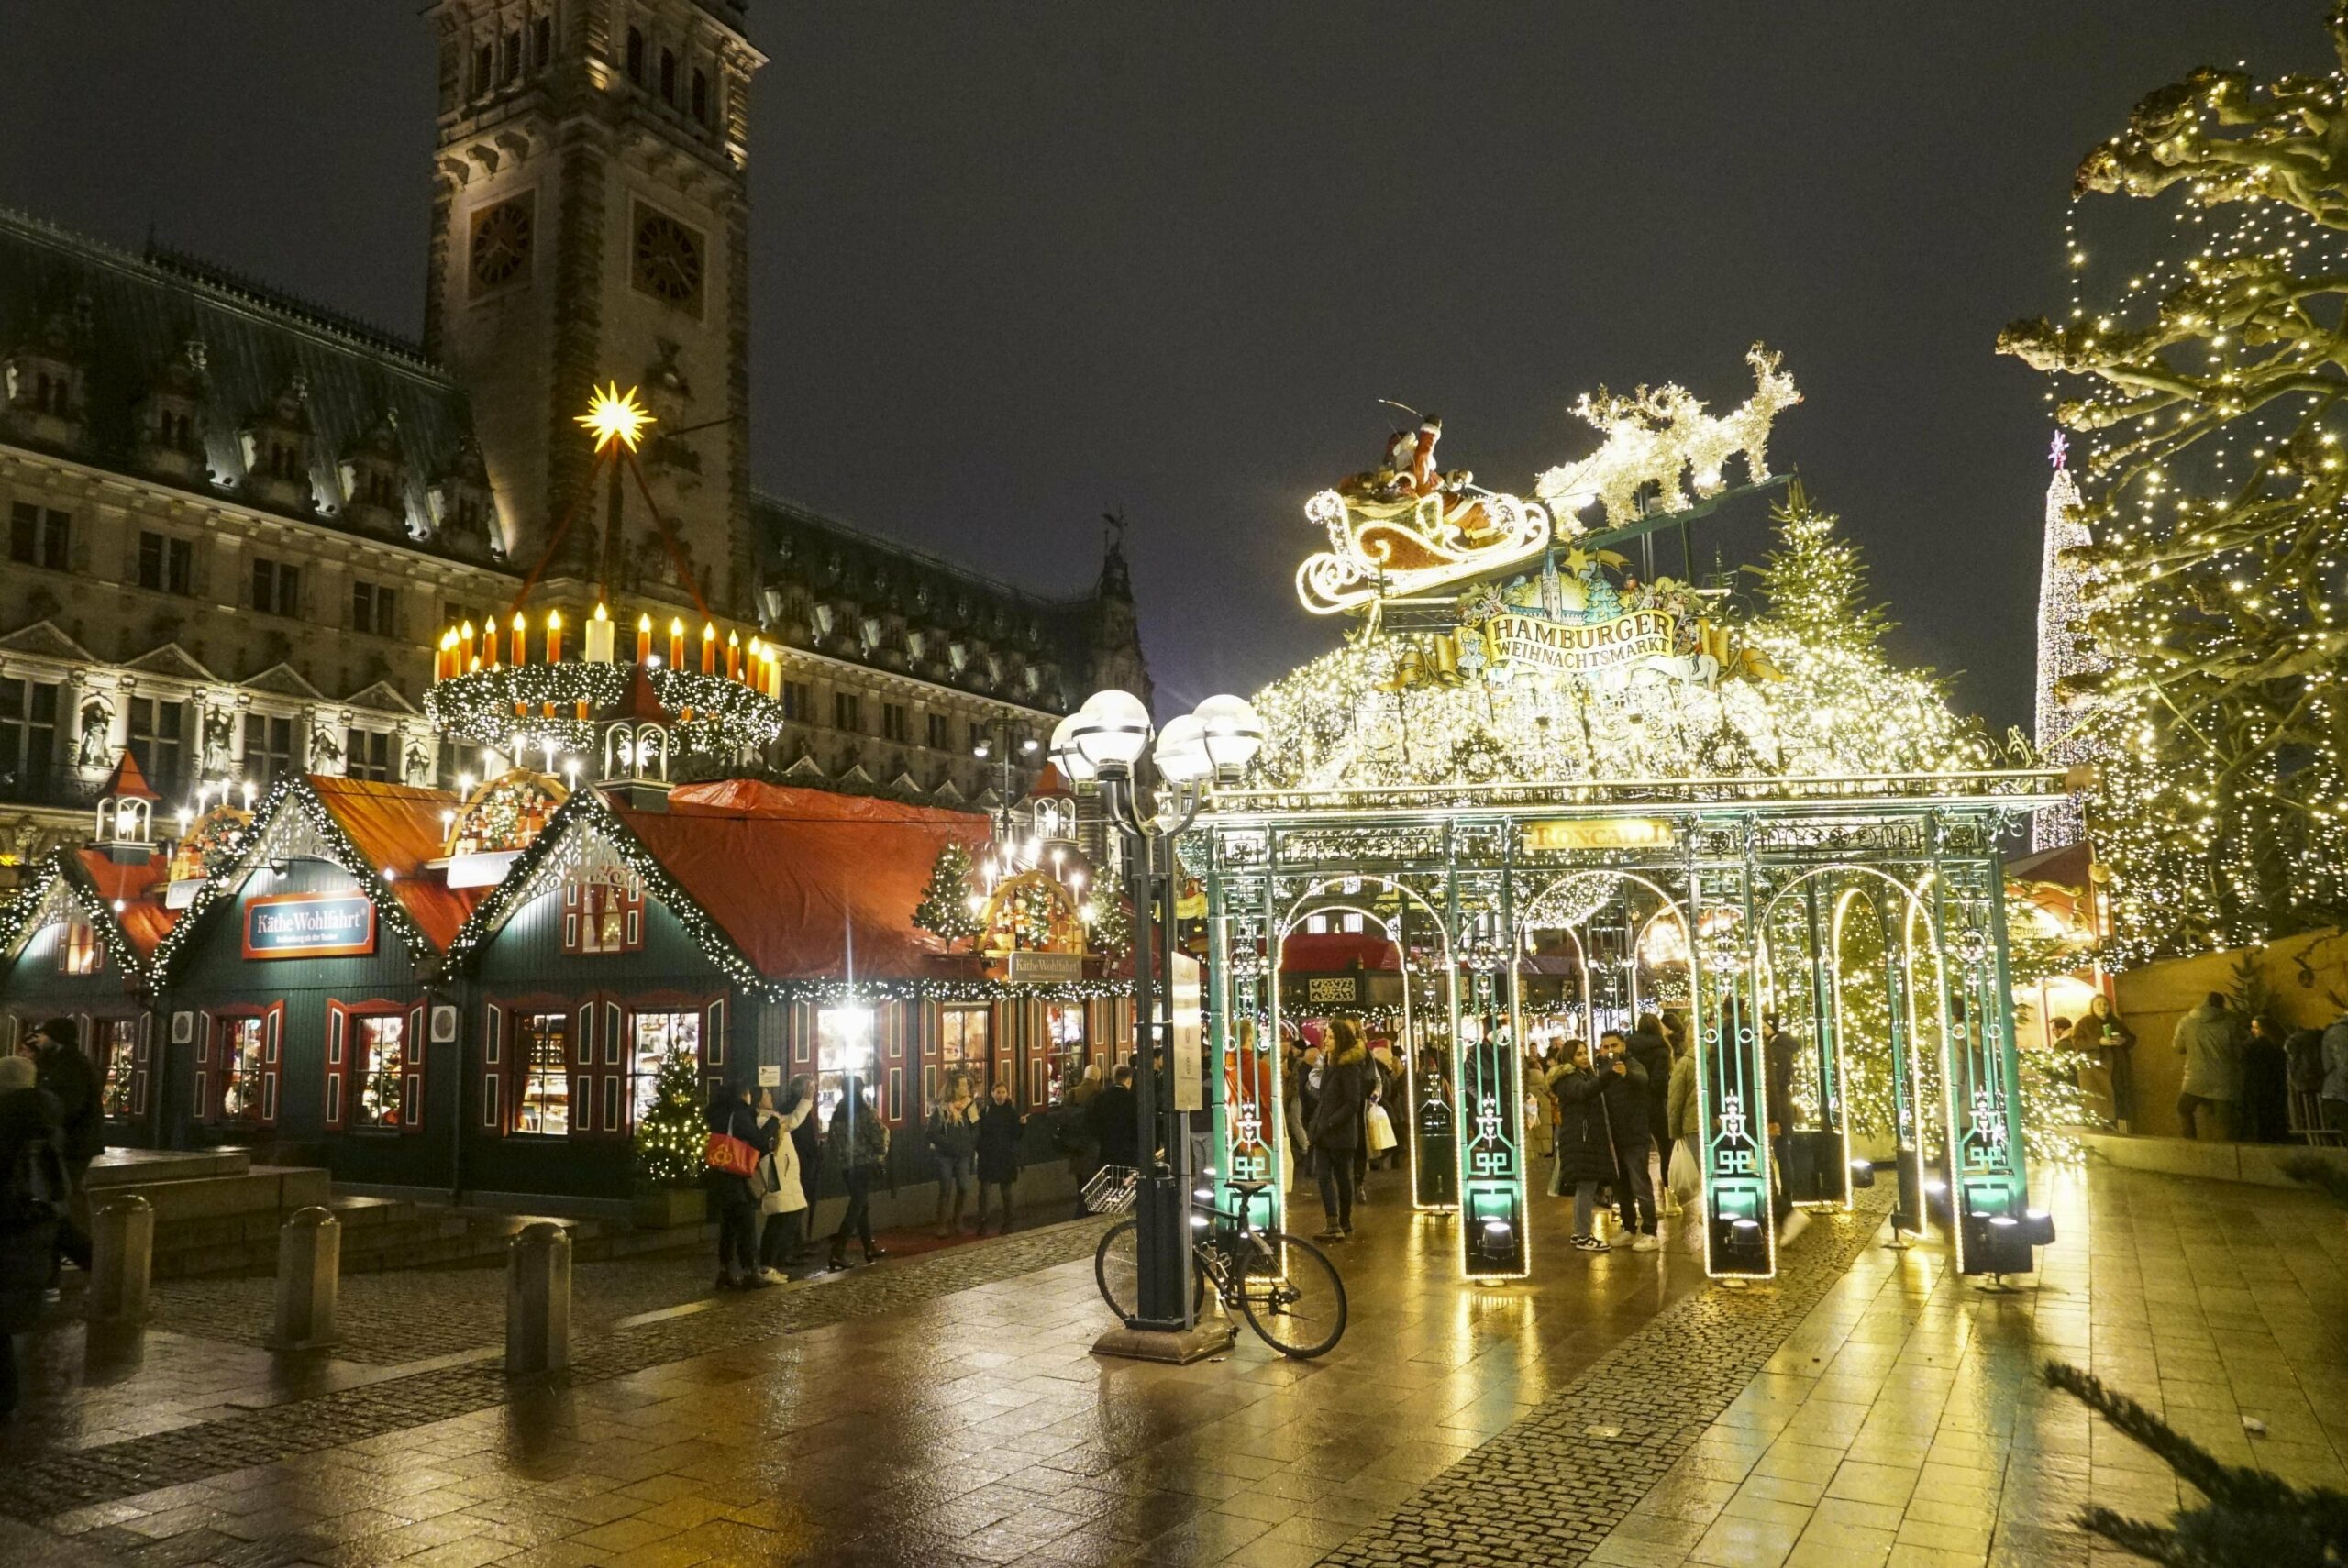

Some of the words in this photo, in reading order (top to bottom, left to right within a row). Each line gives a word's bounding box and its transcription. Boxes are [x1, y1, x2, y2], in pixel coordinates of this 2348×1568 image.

[1492, 613, 1670, 649] HAMBURGER
[1494, 637, 1670, 668] WEIHNACHTSMARKT
[1536, 824, 1661, 846] RONCALLI
[258, 913, 293, 933] Käthe
[294, 909, 360, 930] Wohlfahrt
[1016, 958, 1038, 972] Käthe
[1038, 959, 1078, 972] Wohlfahrt
